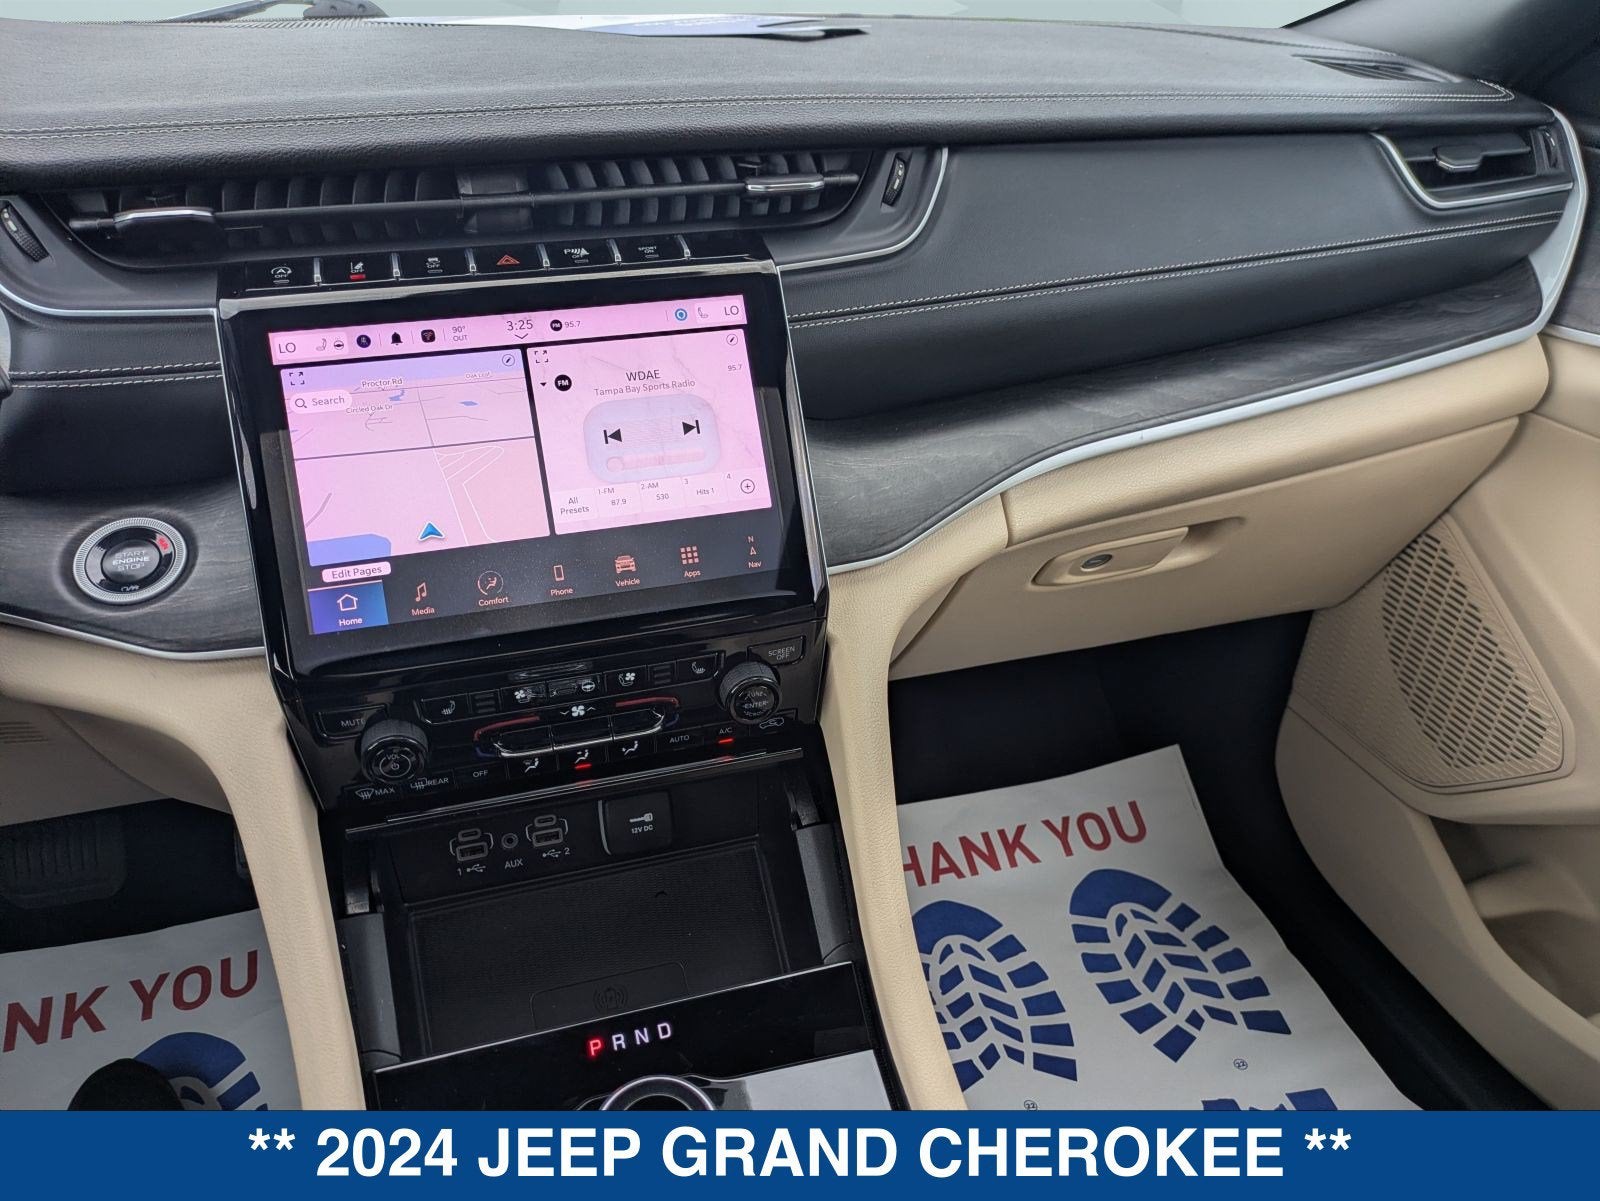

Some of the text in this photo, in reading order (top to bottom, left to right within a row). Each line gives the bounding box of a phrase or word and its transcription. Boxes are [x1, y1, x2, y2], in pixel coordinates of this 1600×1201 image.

[724, 305, 740, 316] LO
[506, 319, 534, 332] 3:25
[564, 320, 581, 329] 95.7
[453, 334, 468, 342] OUT
[278, 342, 297, 354] LO
[727, 364, 742, 372] 95.7
[625, 369, 660, 382] WDAE
[361, 377, 403, 388] Proctor Rd
[594, 378, 696, 398] Tampa Bay Sports Radio
[311, 395, 345, 407] Search
[345, 404, 368, 414] Circled
[369, 405, 383, 413] Oak
[641, 481, 659, 490] 2-AM
[598, 487, 615, 495] 1-FM
[696, 487, 710, 496] Hits
[568, 496, 579, 505] All
[655, 492, 670, 501] 530
[611, 498, 627, 506] 87.9
[560, 505, 590, 516] Presets
[112, 556, 150, 566] ENGINE
[331, 565, 383, 580] Edit Pages
[684, 569, 702, 578] Apps
[615, 578, 641, 588] Vehicle
[550, 587, 573, 597] Phone
[478, 596, 509, 607] Comfort
[411, 606, 435, 617] Media
[338, 616, 363, 627] Home
[768, 646, 796, 658] SCREEN
[669, 734, 690, 743] AUTO
[386, 753, 400, 761] VOL
[473, 770, 488, 778] OFF
[428, 777, 449, 786] REAR
[375, 787, 396, 797] MAX
[631, 824, 654, 835] 12V DC
[1041, 800, 1147, 858] YOU
[564, 847, 571, 857] 2
[504, 859, 523, 870] AUX
[129, 949, 259, 1022] YOU
[589, 1022, 672, 1056] P R N D
